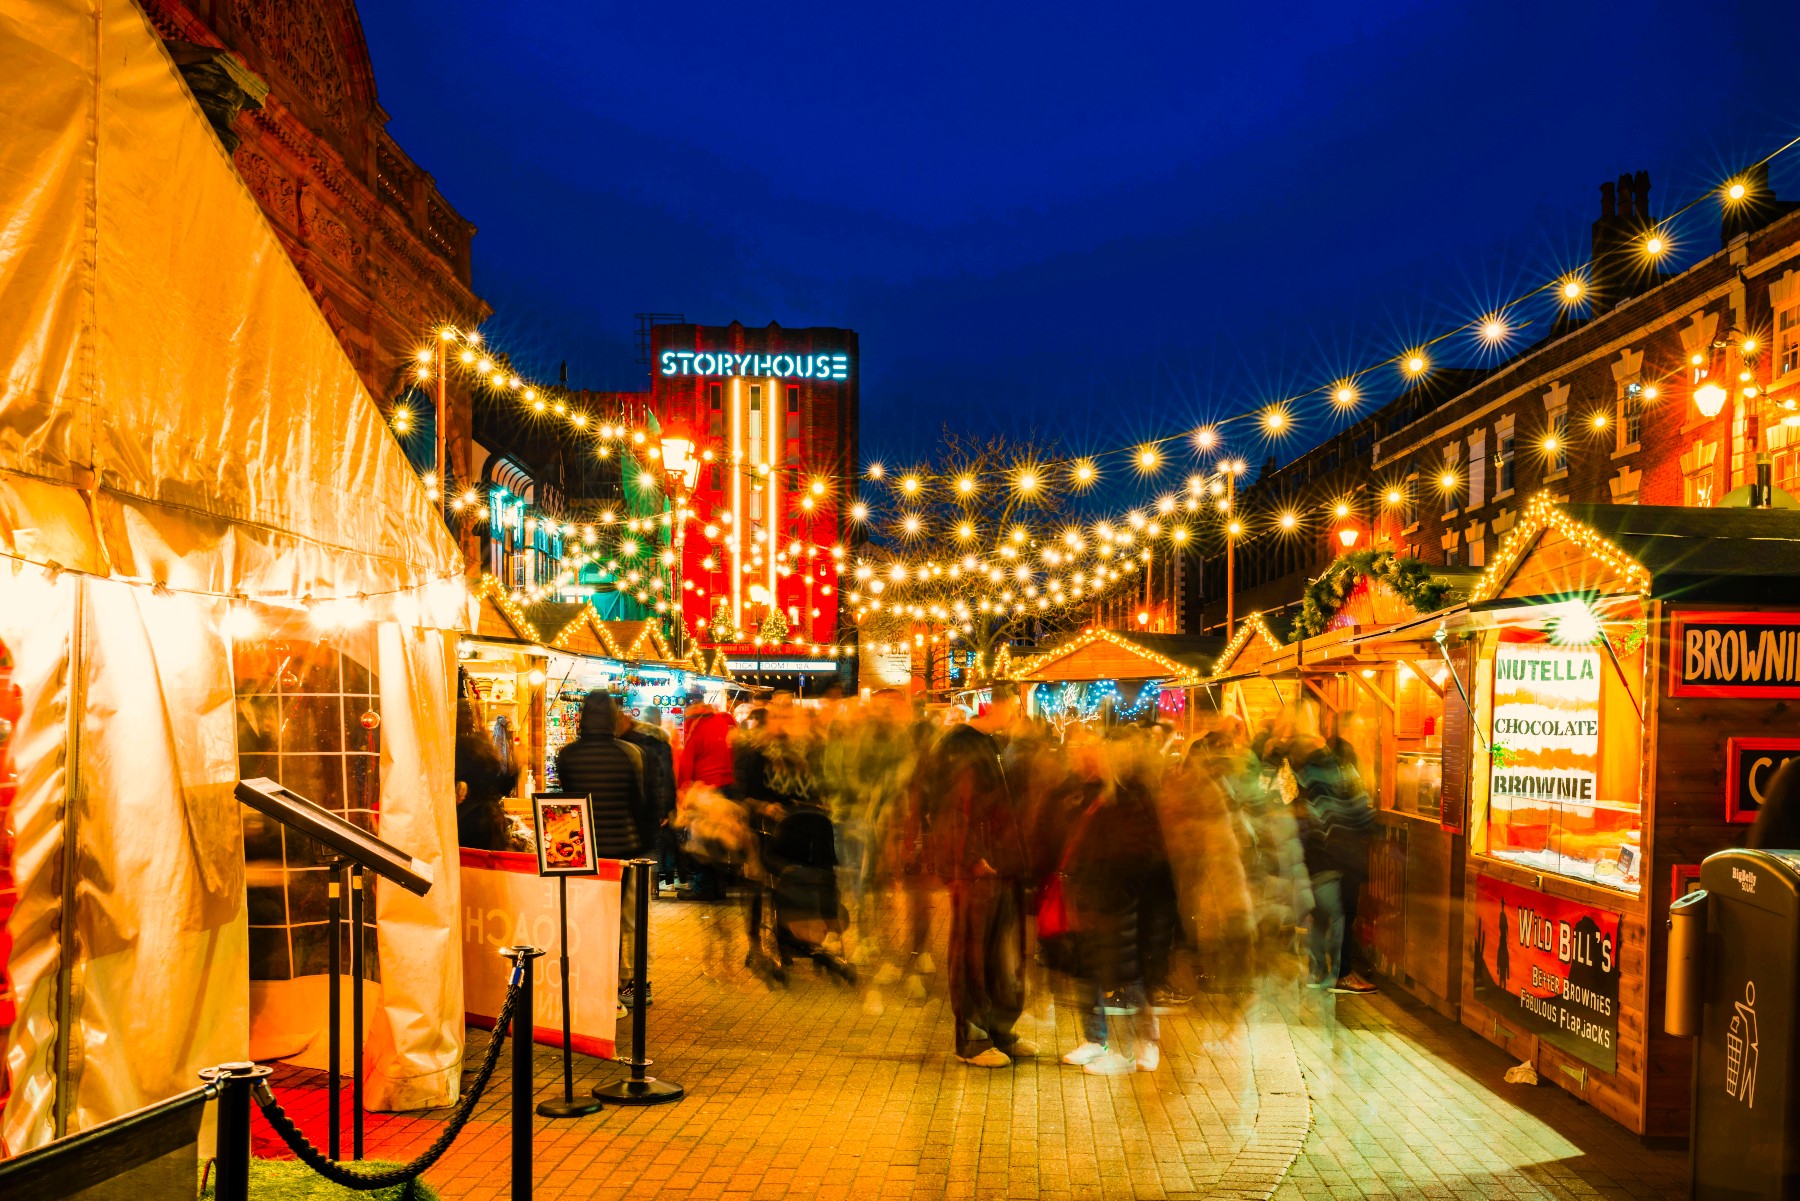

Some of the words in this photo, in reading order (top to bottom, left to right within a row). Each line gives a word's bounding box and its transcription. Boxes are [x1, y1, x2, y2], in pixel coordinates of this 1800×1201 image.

[661, 351, 847, 378] STORYHOUSE
[1685, 629, 1800, 682] BROWNI
[1497, 658, 1594, 681] NUTELLA
[1494, 718, 1598, 736] CHOCOLATE
[1493, 775, 1592, 800] BROWNIE
[1732, 866, 1757, 887] BigBelly
